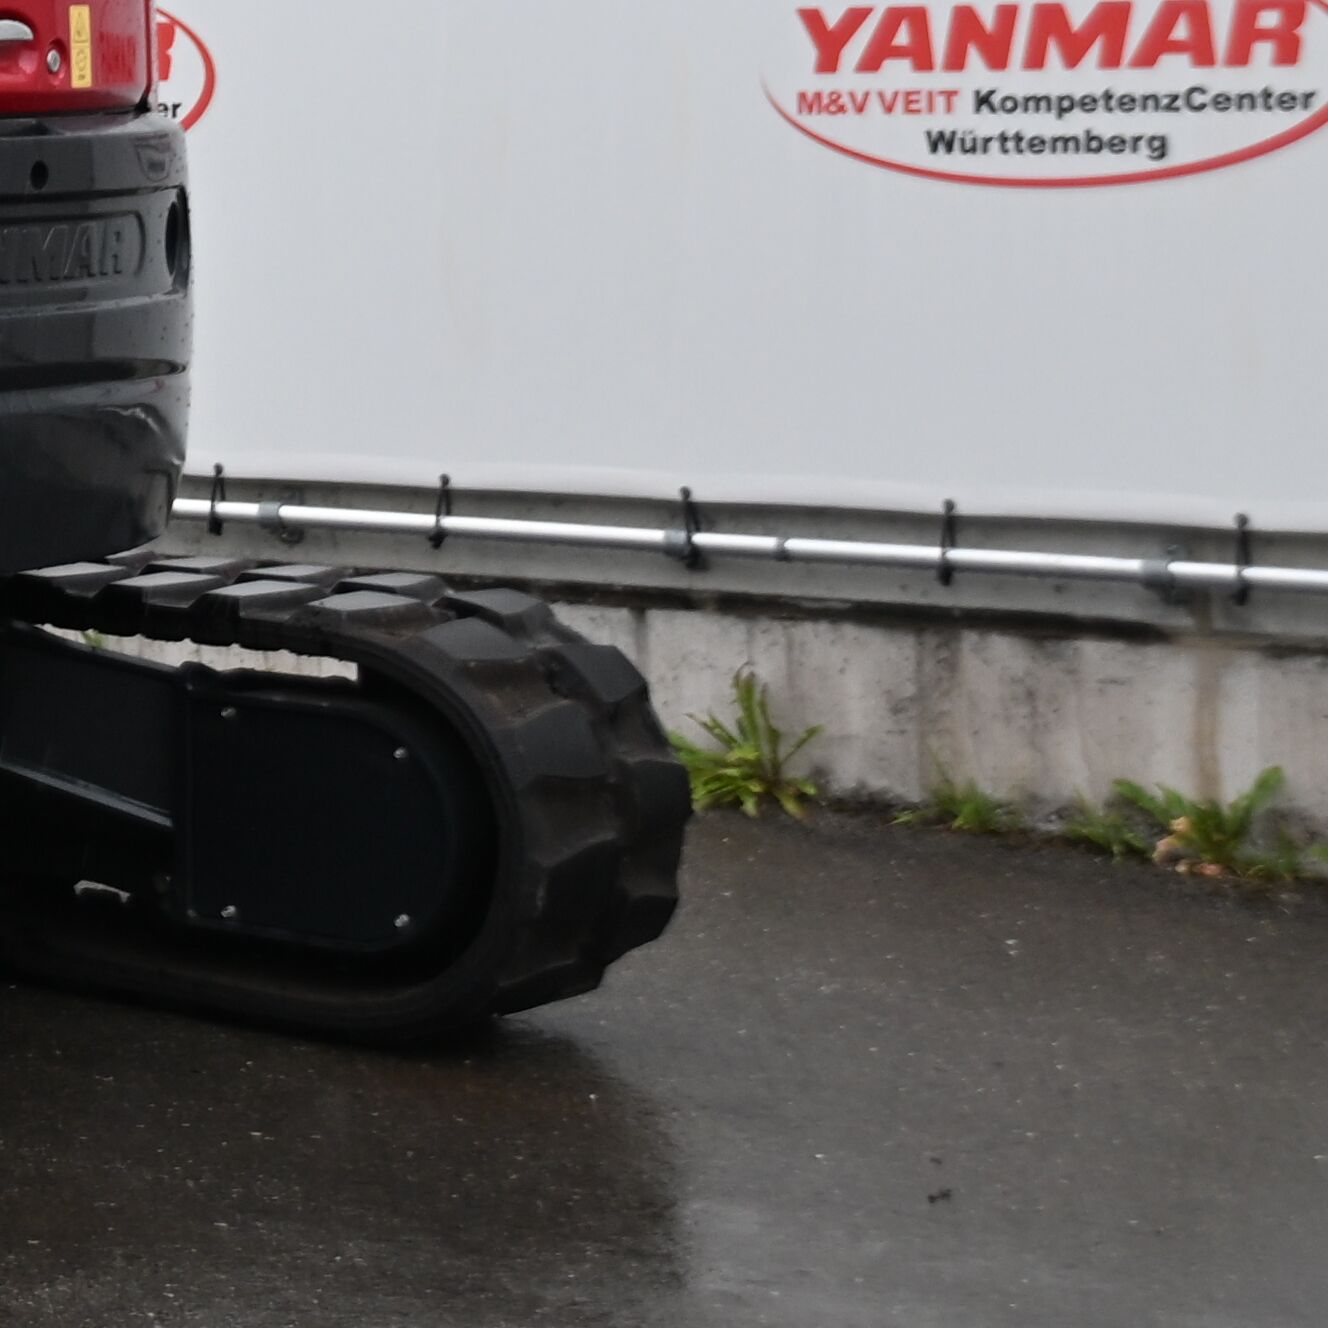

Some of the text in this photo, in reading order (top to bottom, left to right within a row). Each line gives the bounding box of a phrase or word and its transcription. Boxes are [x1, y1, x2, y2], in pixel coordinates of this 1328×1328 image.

[796, 85, 1317, 119] M&V VEIT KompetenzCenter
[925, 127, 1170, 160] Württemberg
